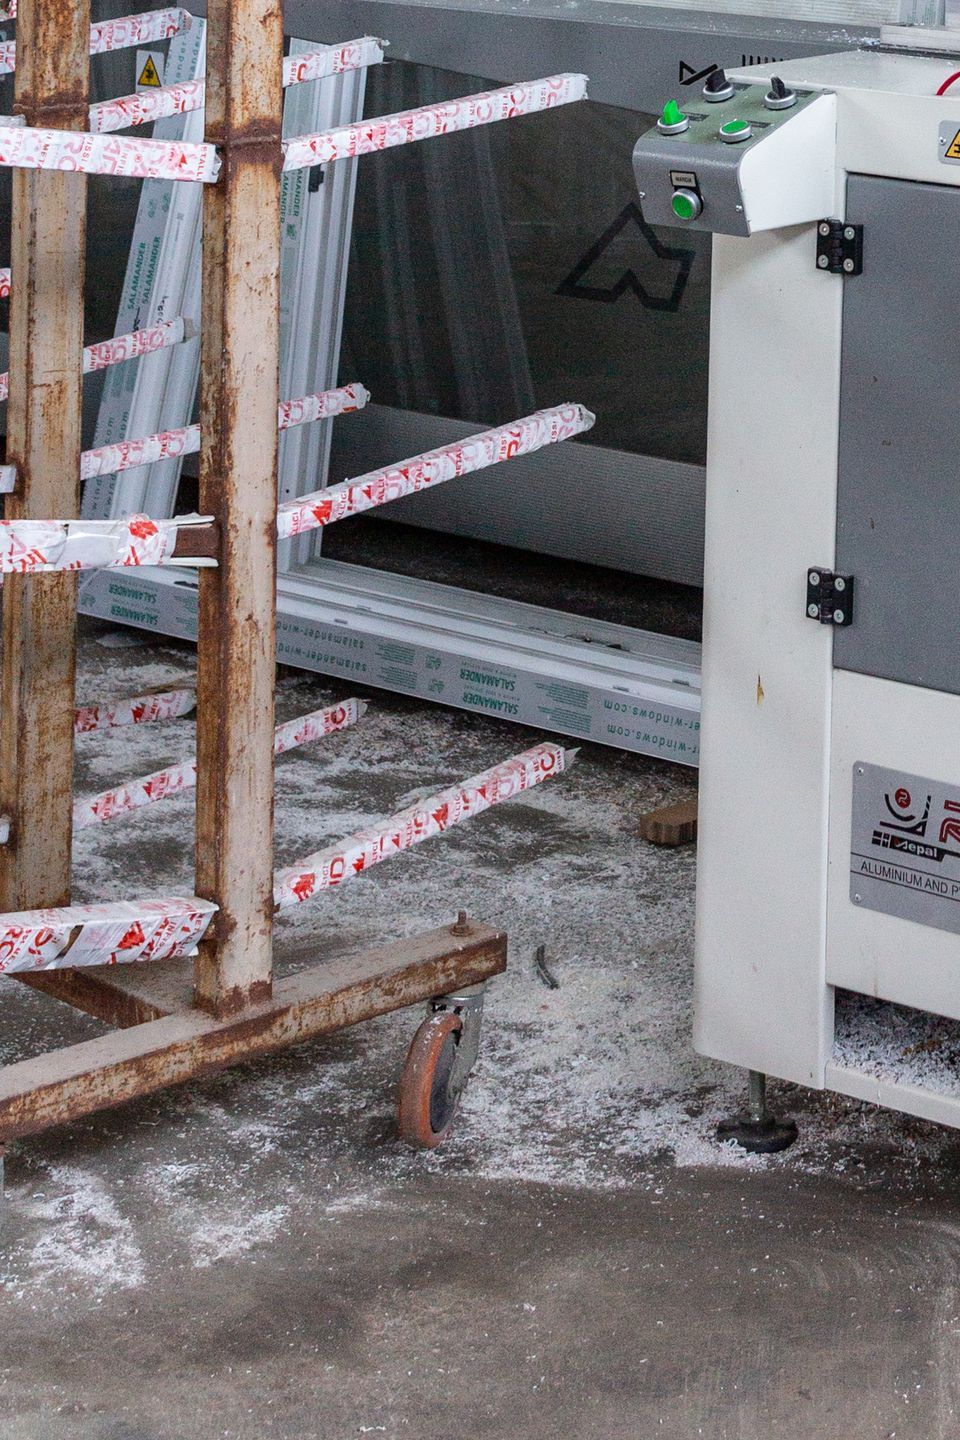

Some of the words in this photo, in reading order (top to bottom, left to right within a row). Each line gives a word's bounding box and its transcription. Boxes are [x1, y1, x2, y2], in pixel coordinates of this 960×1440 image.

[128, 242, 146, 310] SALAMANDER
[110, 605, 158, 626] SALAMANDER
[460, 668, 516, 691] SALAMANDER
[463, 692, 519, 715] SALAMANDER
[860, 860, 922, 888] ALUMINIUM
[924, 874, 948, 895] AND
